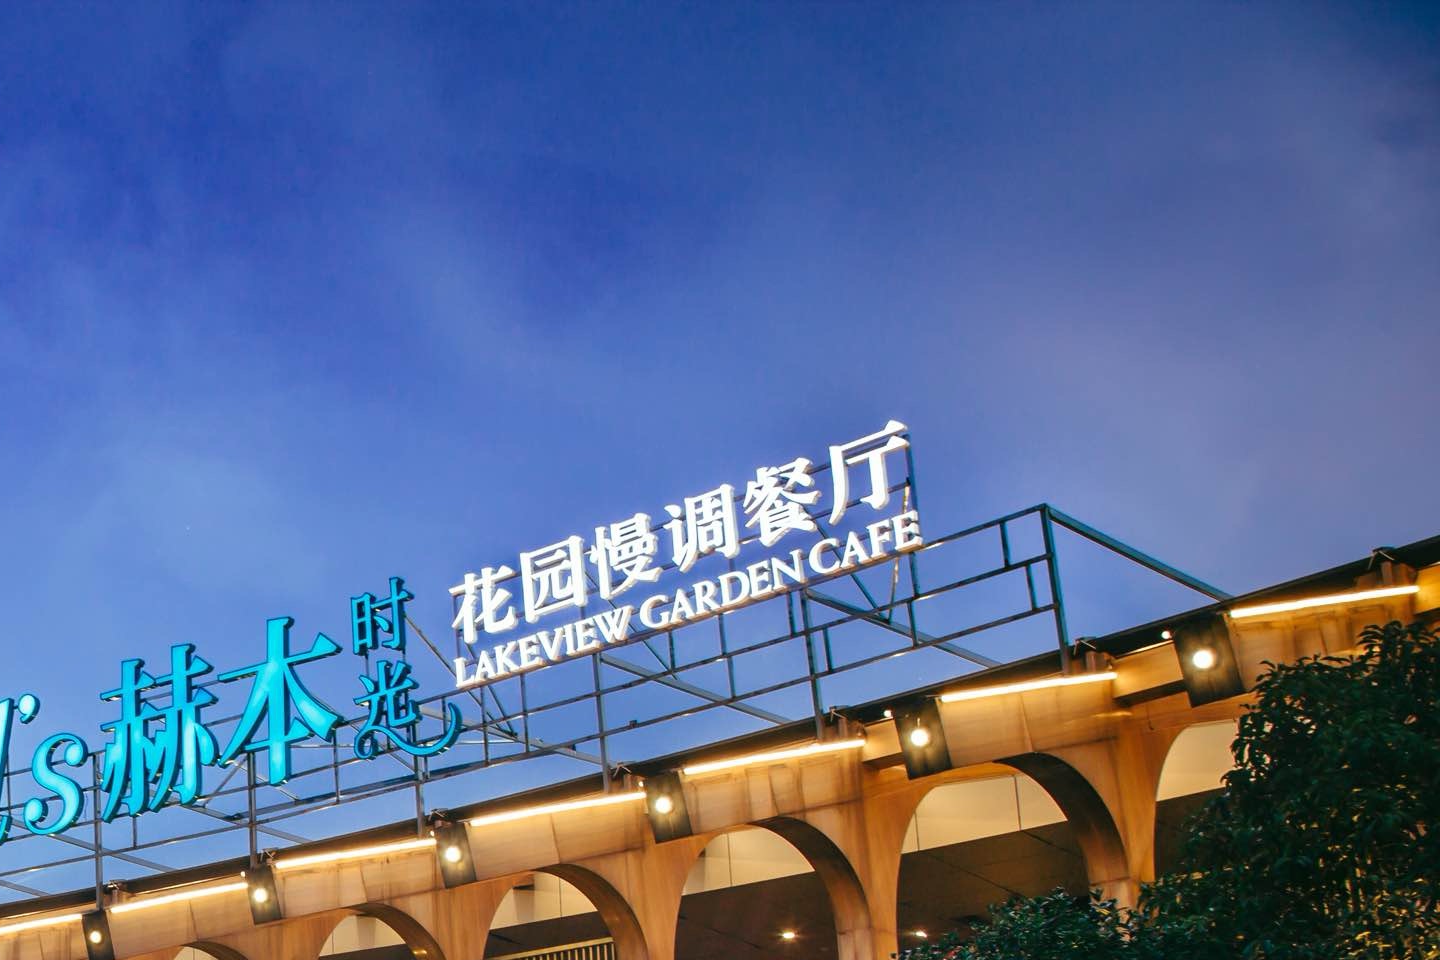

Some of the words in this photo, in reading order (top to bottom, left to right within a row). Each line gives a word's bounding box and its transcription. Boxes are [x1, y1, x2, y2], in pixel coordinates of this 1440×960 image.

[449, 419, 910, 645] 花园慢调餐厅
[453, 604, 635, 688] LAKEVIEW
[639, 548, 809, 629] GARDEN
[809, 510, 924, 575] CAFE
[99, 615, 344, 824] 赫本
[350, 576, 463, 760] 时光
